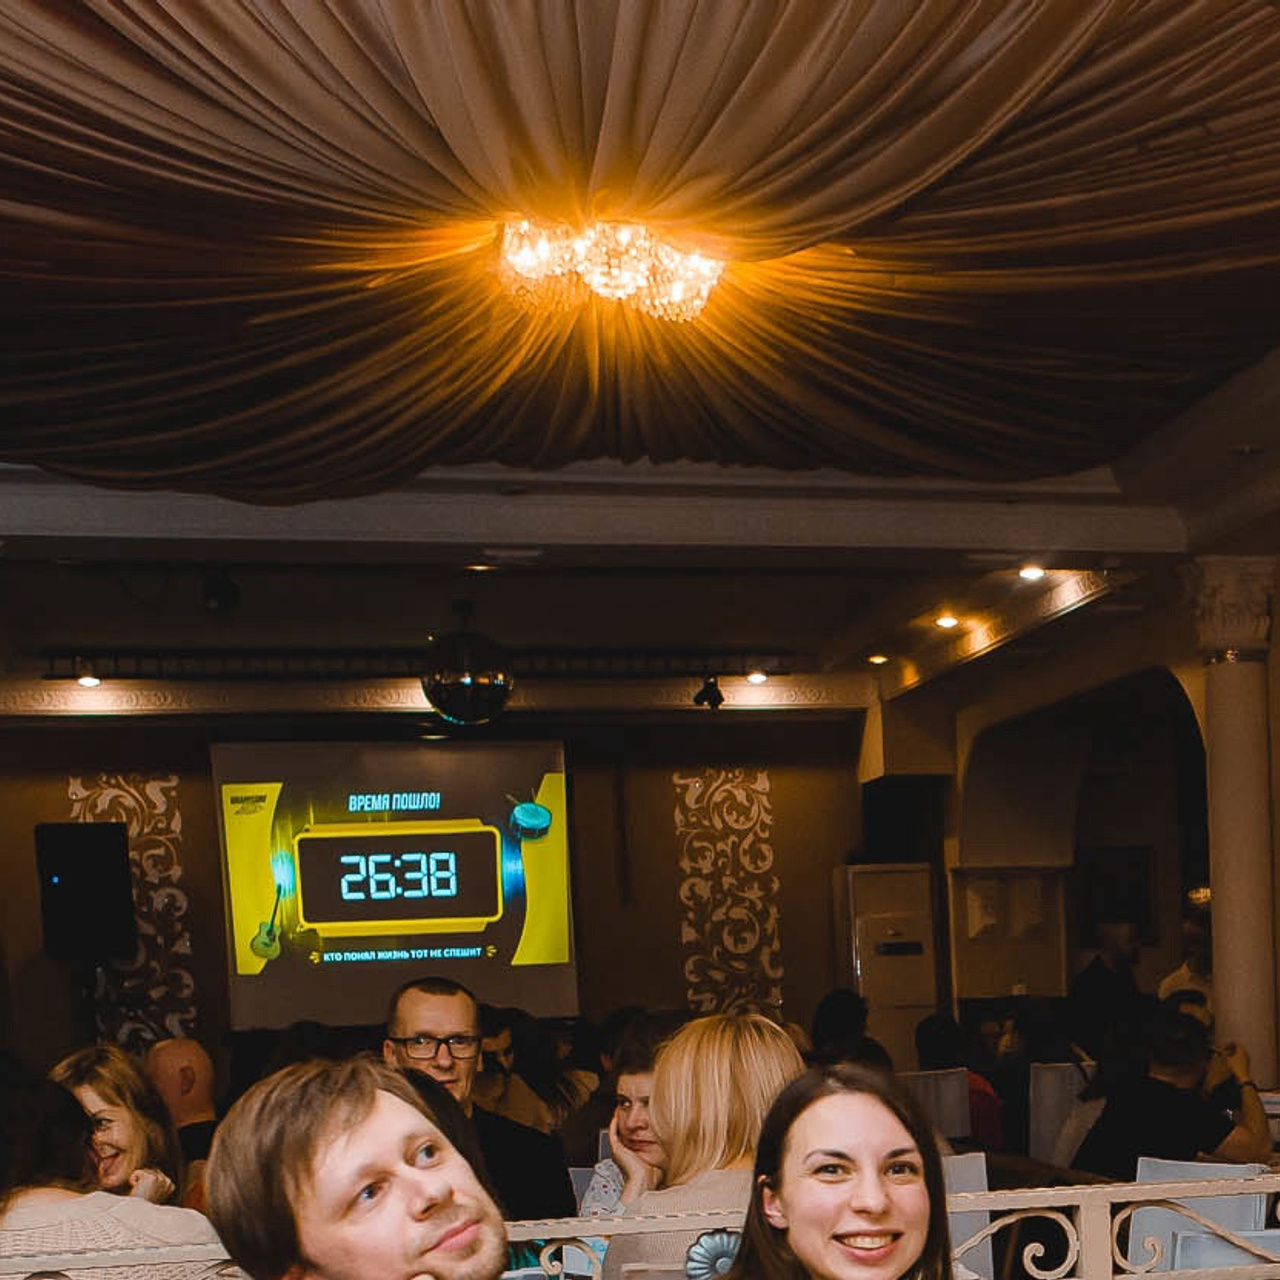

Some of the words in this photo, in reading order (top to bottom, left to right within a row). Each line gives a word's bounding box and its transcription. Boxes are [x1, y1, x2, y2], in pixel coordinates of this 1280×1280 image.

[348, 793, 390, 812] ВРЕМЯ
[391, 791, 441, 810] ПОШЛО!
[340, 852, 458, 900] 26:38
[323, 952, 343, 962] КТО
[343, 951, 376, 962] ПОНЯЛ
[377, 950, 410, 961] ЖИЗНЬ
[410, 950, 428, 960] ТОТ
[429, 949, 443, 959] НЕ
[443, 947, 483, 959] СПЕШИТ
